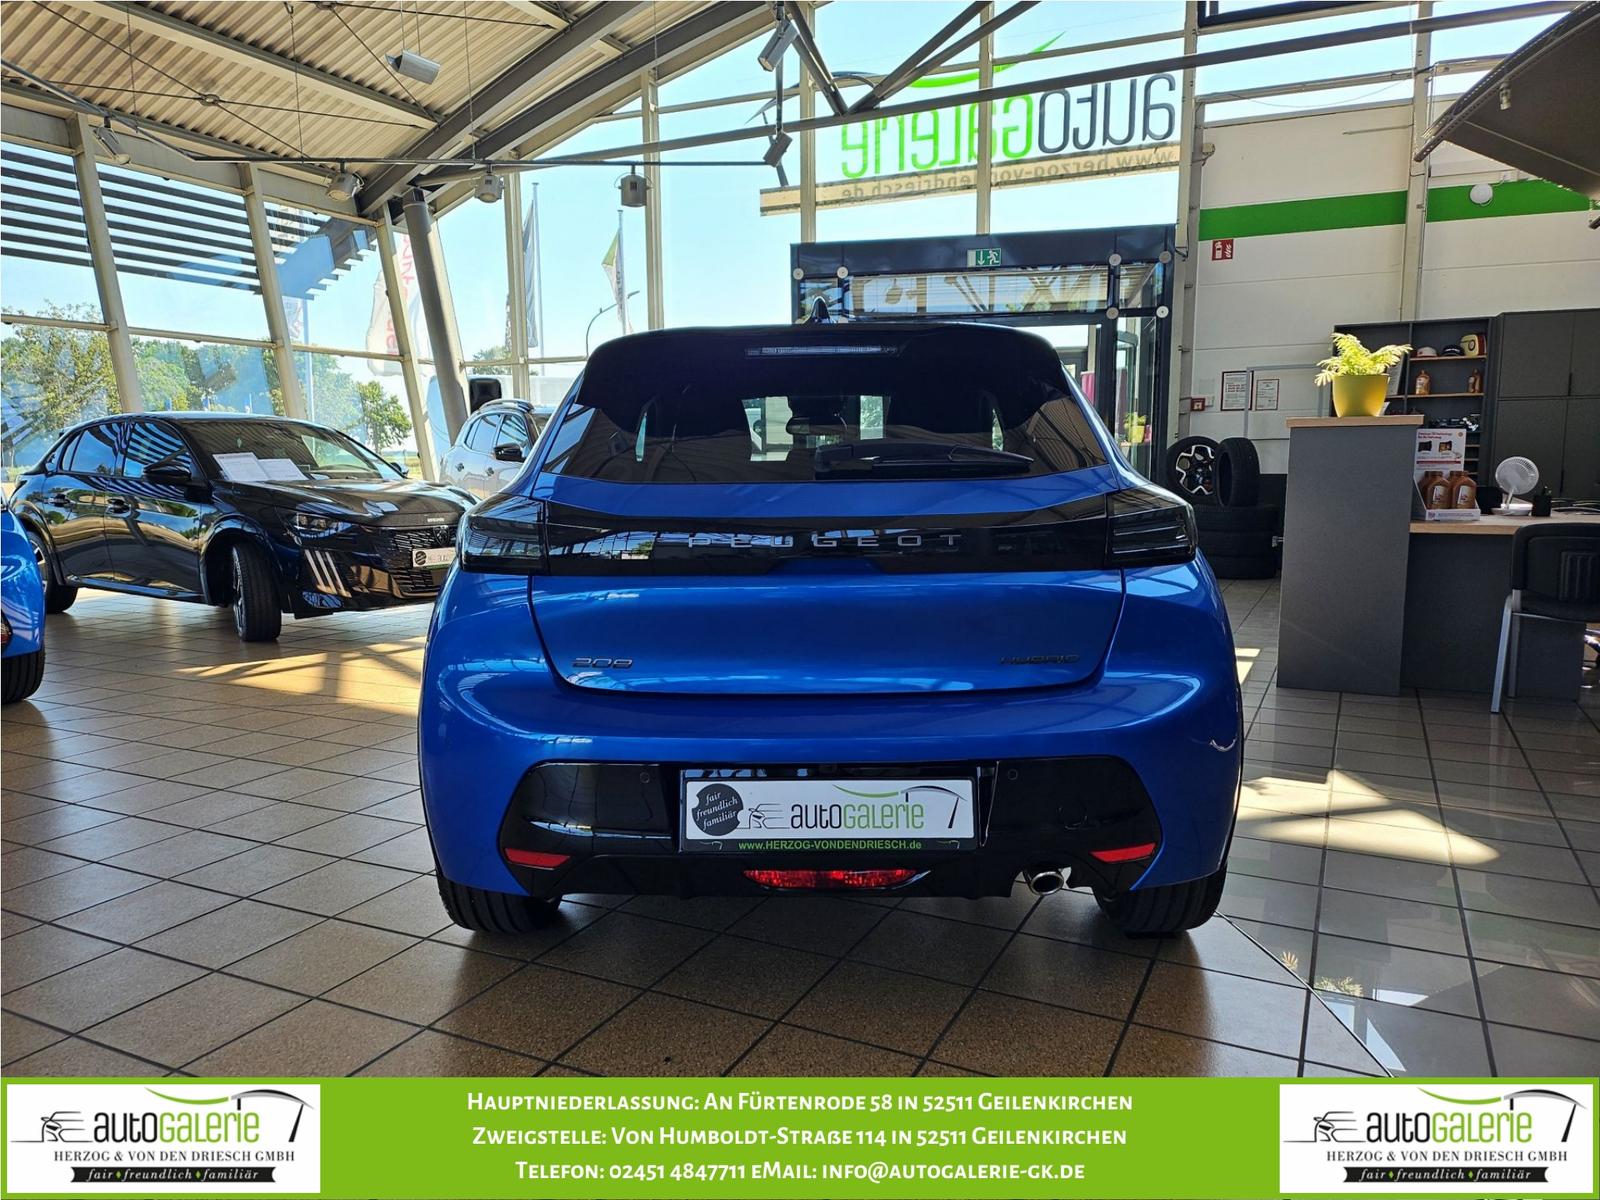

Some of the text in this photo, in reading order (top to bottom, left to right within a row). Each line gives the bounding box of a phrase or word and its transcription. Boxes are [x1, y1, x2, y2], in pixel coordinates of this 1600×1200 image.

[688, 534, 962, 548] PEUGEOT
[706, 791, 721, 805] fair
[696, 796, 738, 820] freundlich
[702, 810, 737, 831] familiär
[738, 839, 922, 851] www.HERZOG-VONDENDRIESCH.de
